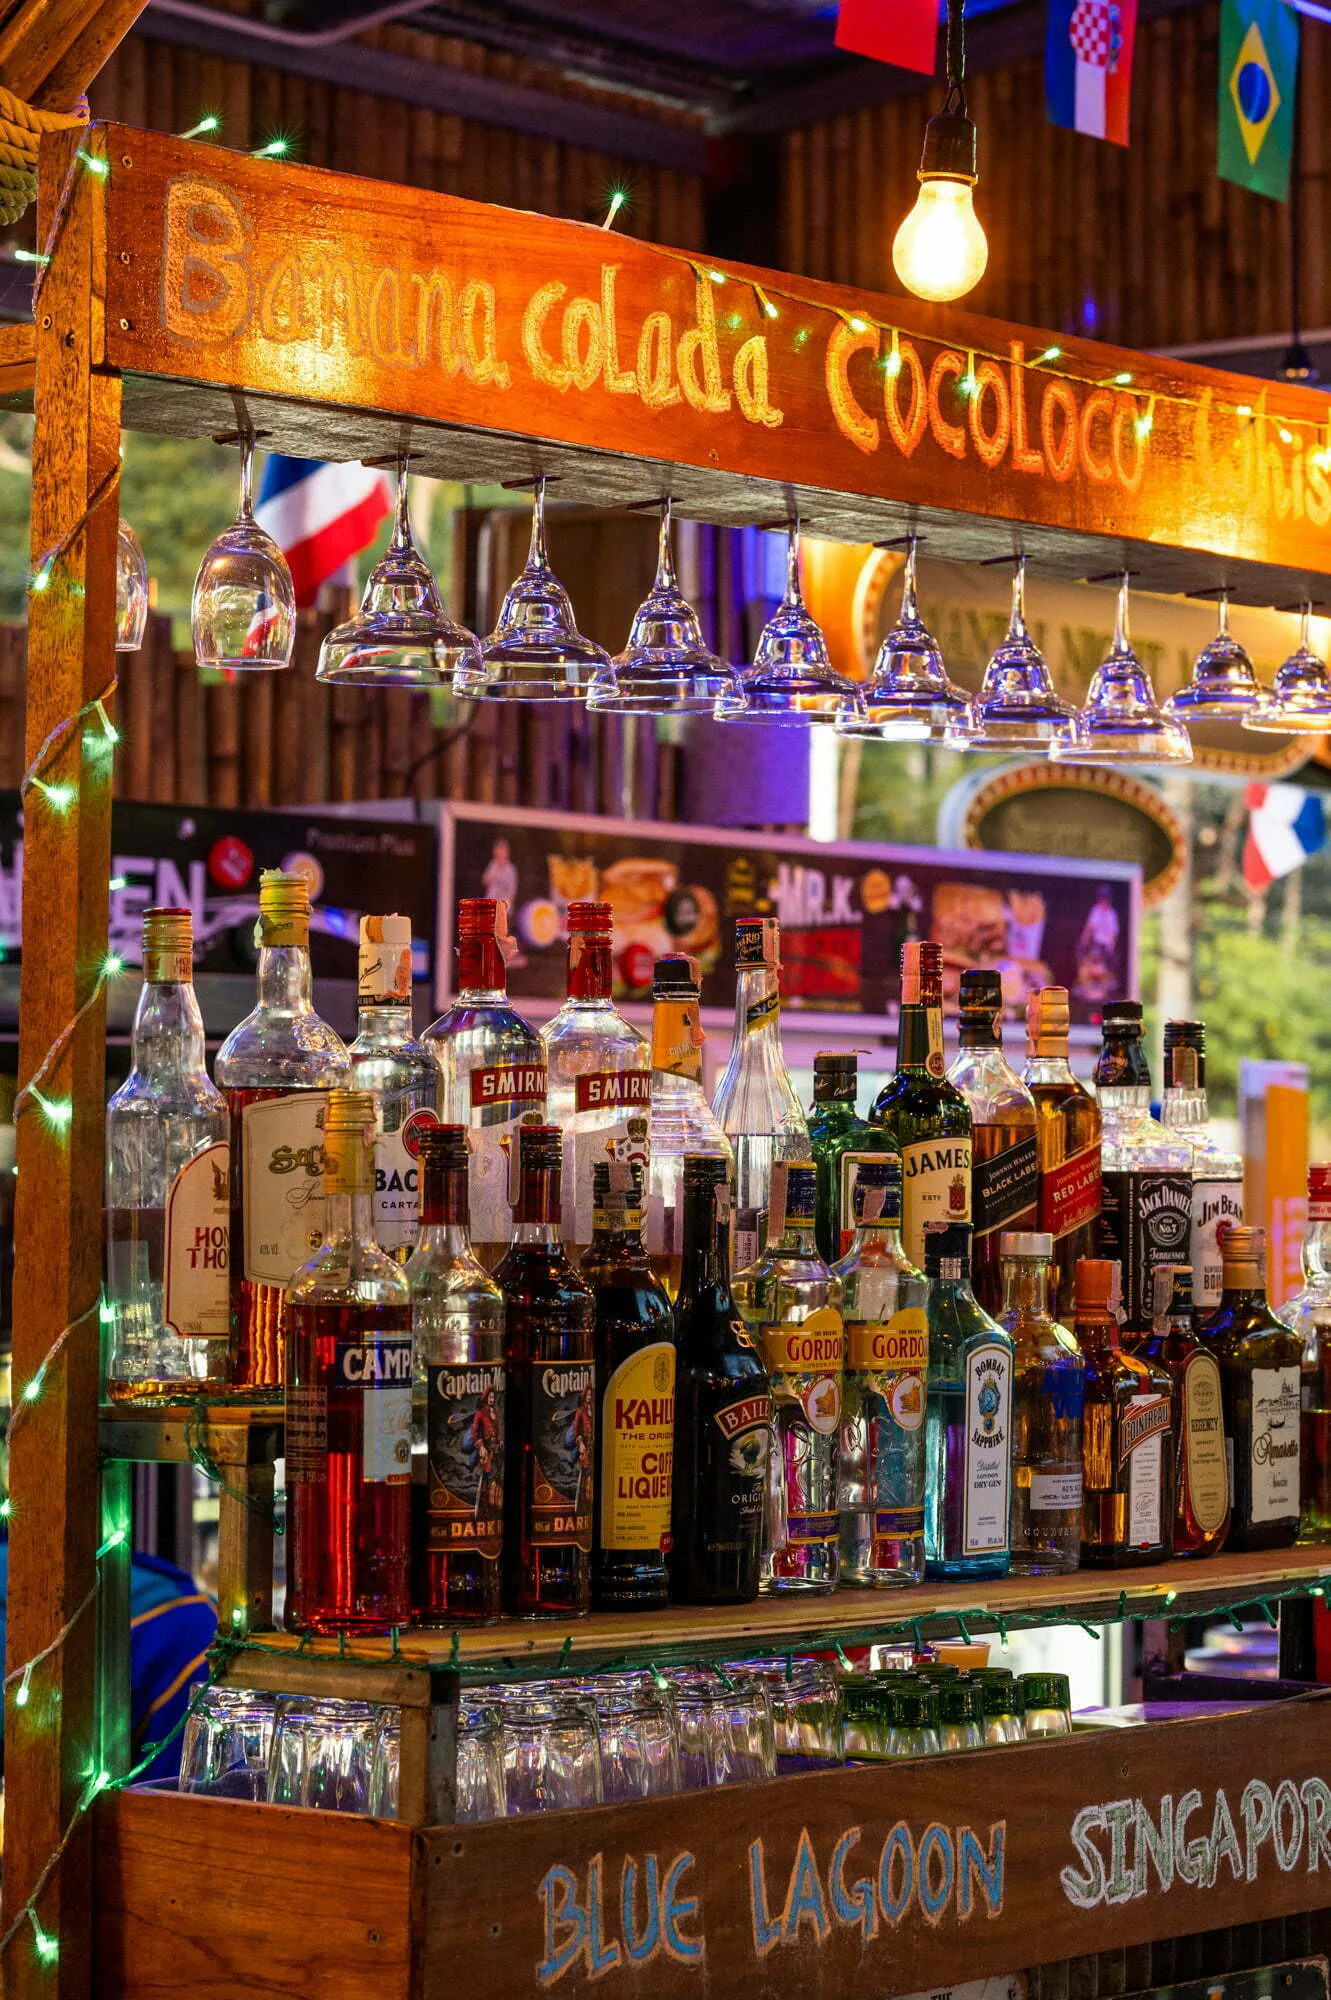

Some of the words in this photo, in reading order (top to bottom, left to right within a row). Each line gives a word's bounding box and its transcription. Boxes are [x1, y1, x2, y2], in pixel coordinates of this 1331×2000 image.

[981, 1175, 1013, 1198] BLACK
[1053, 1184, 1076, 1203] RED
[1197, 1200, 1219, 1228] JIM
[1149, 1247, 1186, 1260] Tennessee
[975, 1359, 1005, 1381] BOMBAY
[437, 1368, 491, 1400] Captain
[972, 1427, 1006, 1449] SAPPHIRE
[1124, 1404, 1169, 1449] COINTREAU
[1253, 1432, 1299, 1467] Amaretto
[974, 1481, 987, 1489] DRY
[989, 1480, 1002, 1488] GIN
[451, 1520, 496, 1538] DARK
[1060, 1777, 1331, 1909] SINGAPOR
[536, 1851, 705, 1987] BLUE
[749, 1820, 1007, 1957] LAGOON
